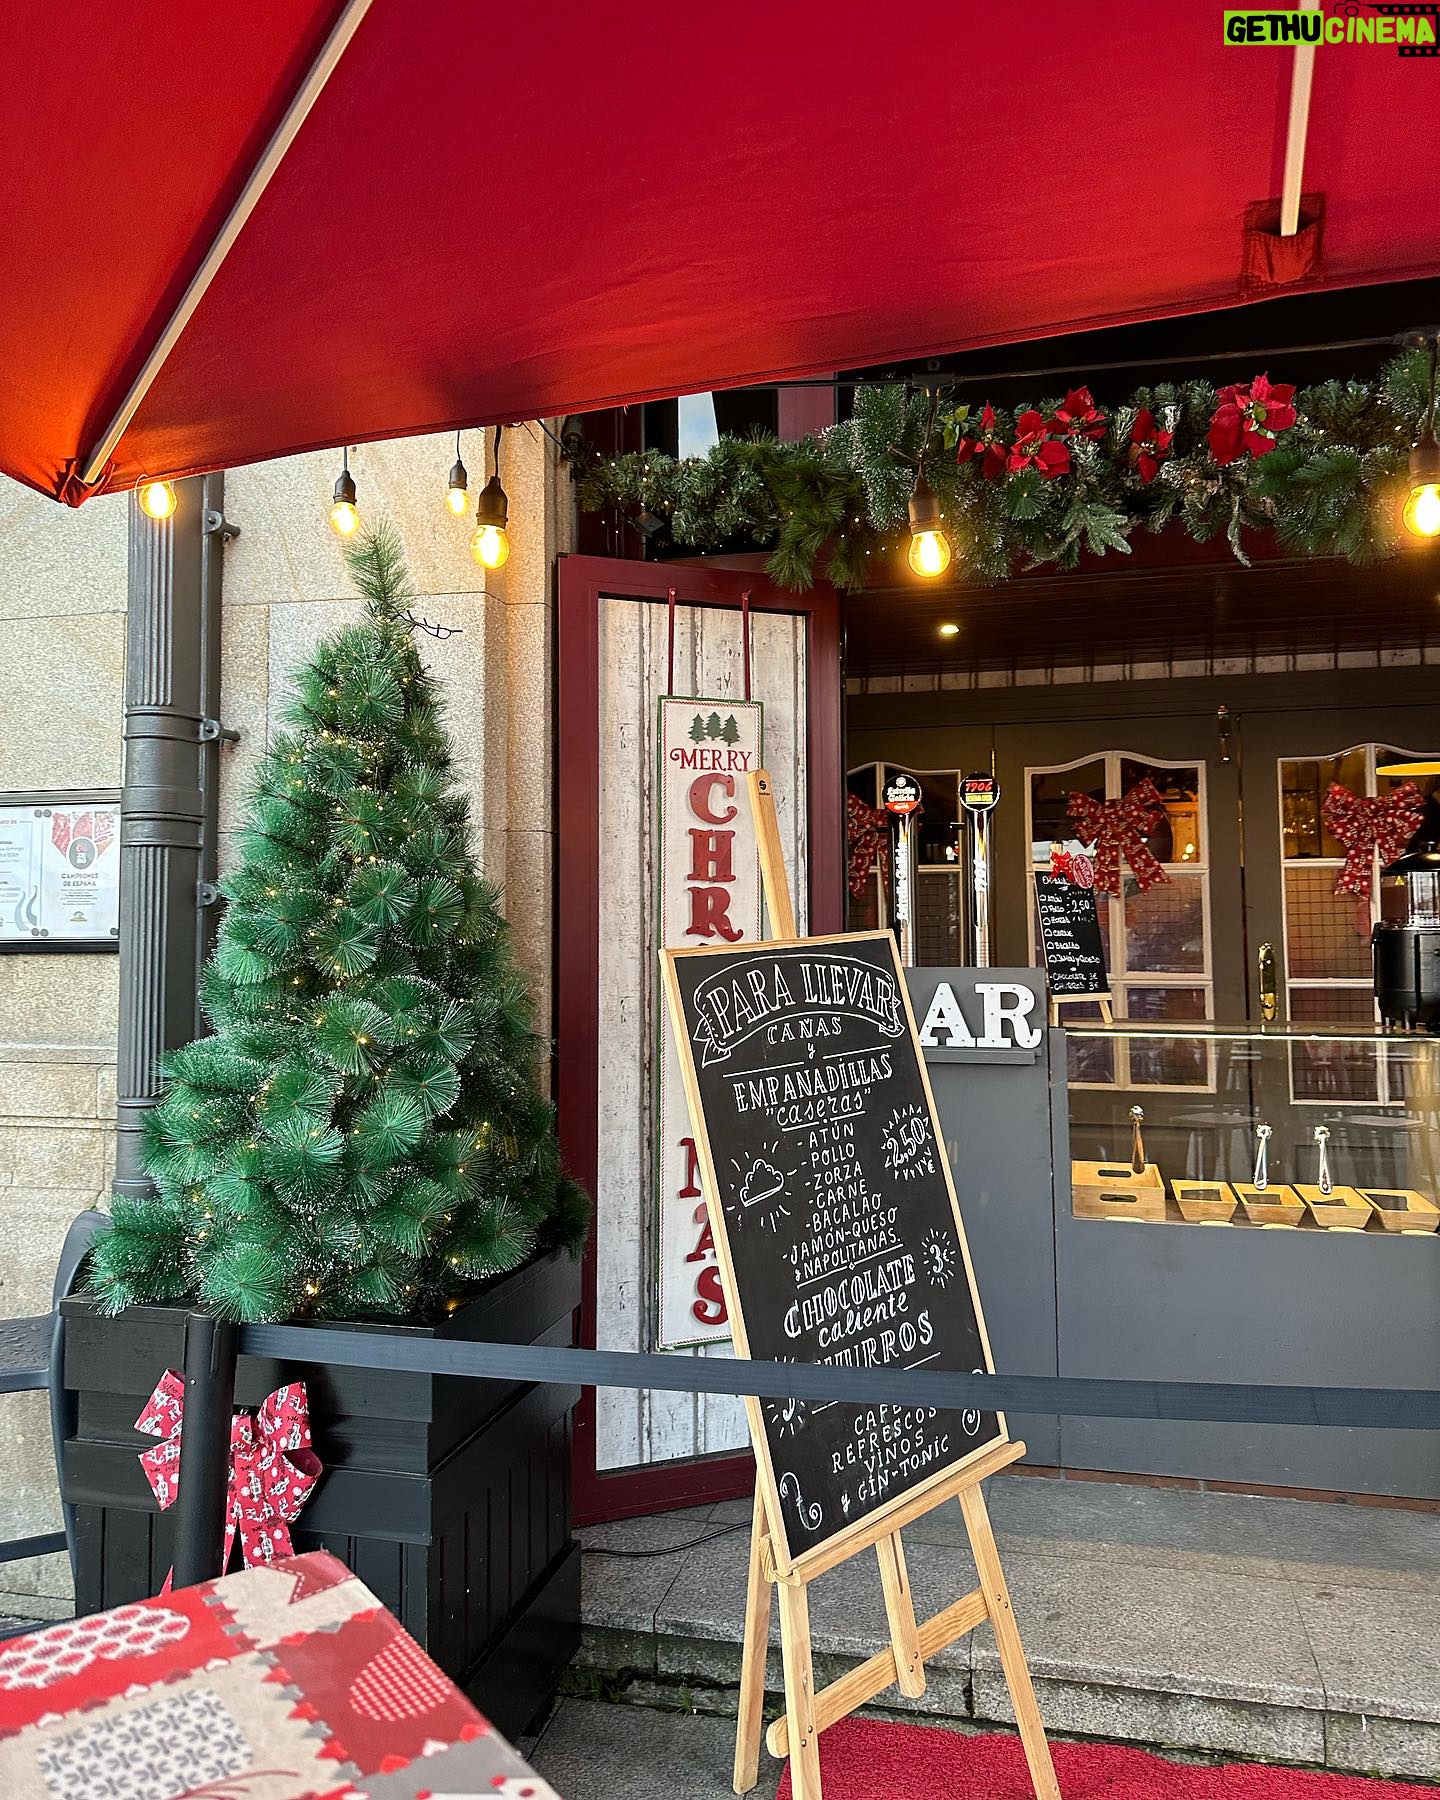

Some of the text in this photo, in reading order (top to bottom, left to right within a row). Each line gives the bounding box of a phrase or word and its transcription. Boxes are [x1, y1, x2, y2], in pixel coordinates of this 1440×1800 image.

[670, 748, 752, 772] MERRY
[965, 782, 993, 792] 1906
[706, 963, 894, 1039] PARA LLEVAR
[767, 1016, 842, 1045] CAÑAS
[806, 1042, 816, 1060] y
[732, 1053, 893, 1113] EMPANADILLAS
[783, 1253, 917, 1339] CHOCOLATE
[818, 1291, 910, 1348] caliente
[840, 1434, 950, 1513] y GIN-TONIC
[863, 1428, 925, 1475] VINOS
